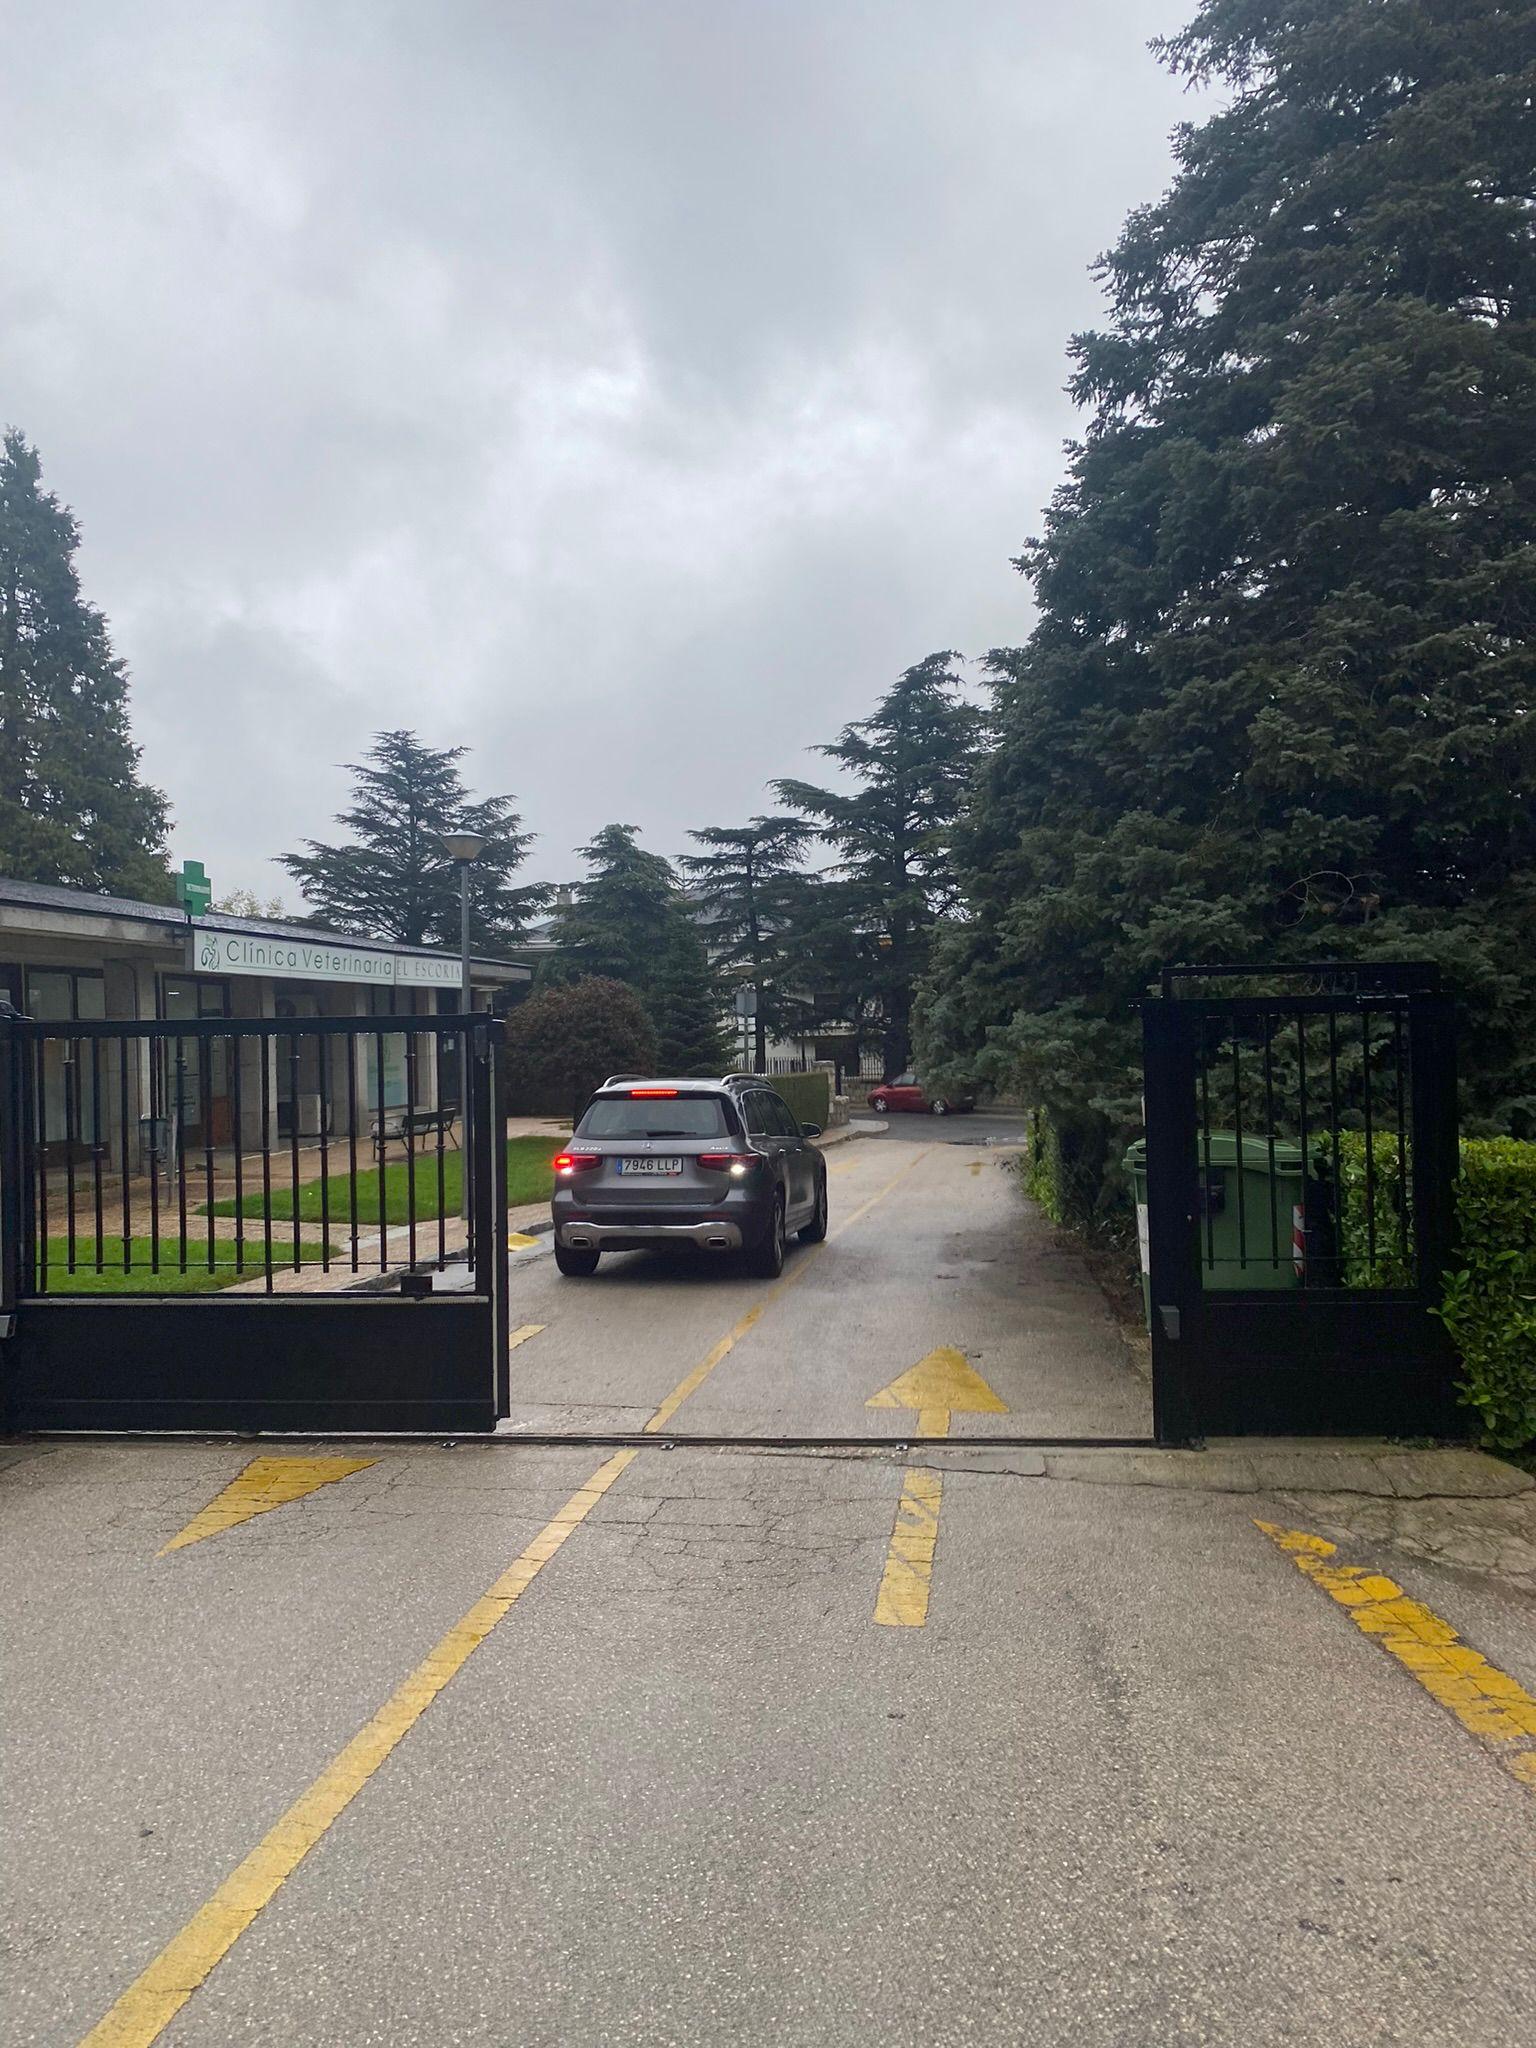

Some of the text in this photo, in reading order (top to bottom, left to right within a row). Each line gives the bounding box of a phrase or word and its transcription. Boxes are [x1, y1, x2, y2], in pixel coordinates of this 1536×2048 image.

[226, 939, 462, 979] Clínica Veterinaria EL ESCORIA
[624, 1159, 679, 1171] 7946 LLP
